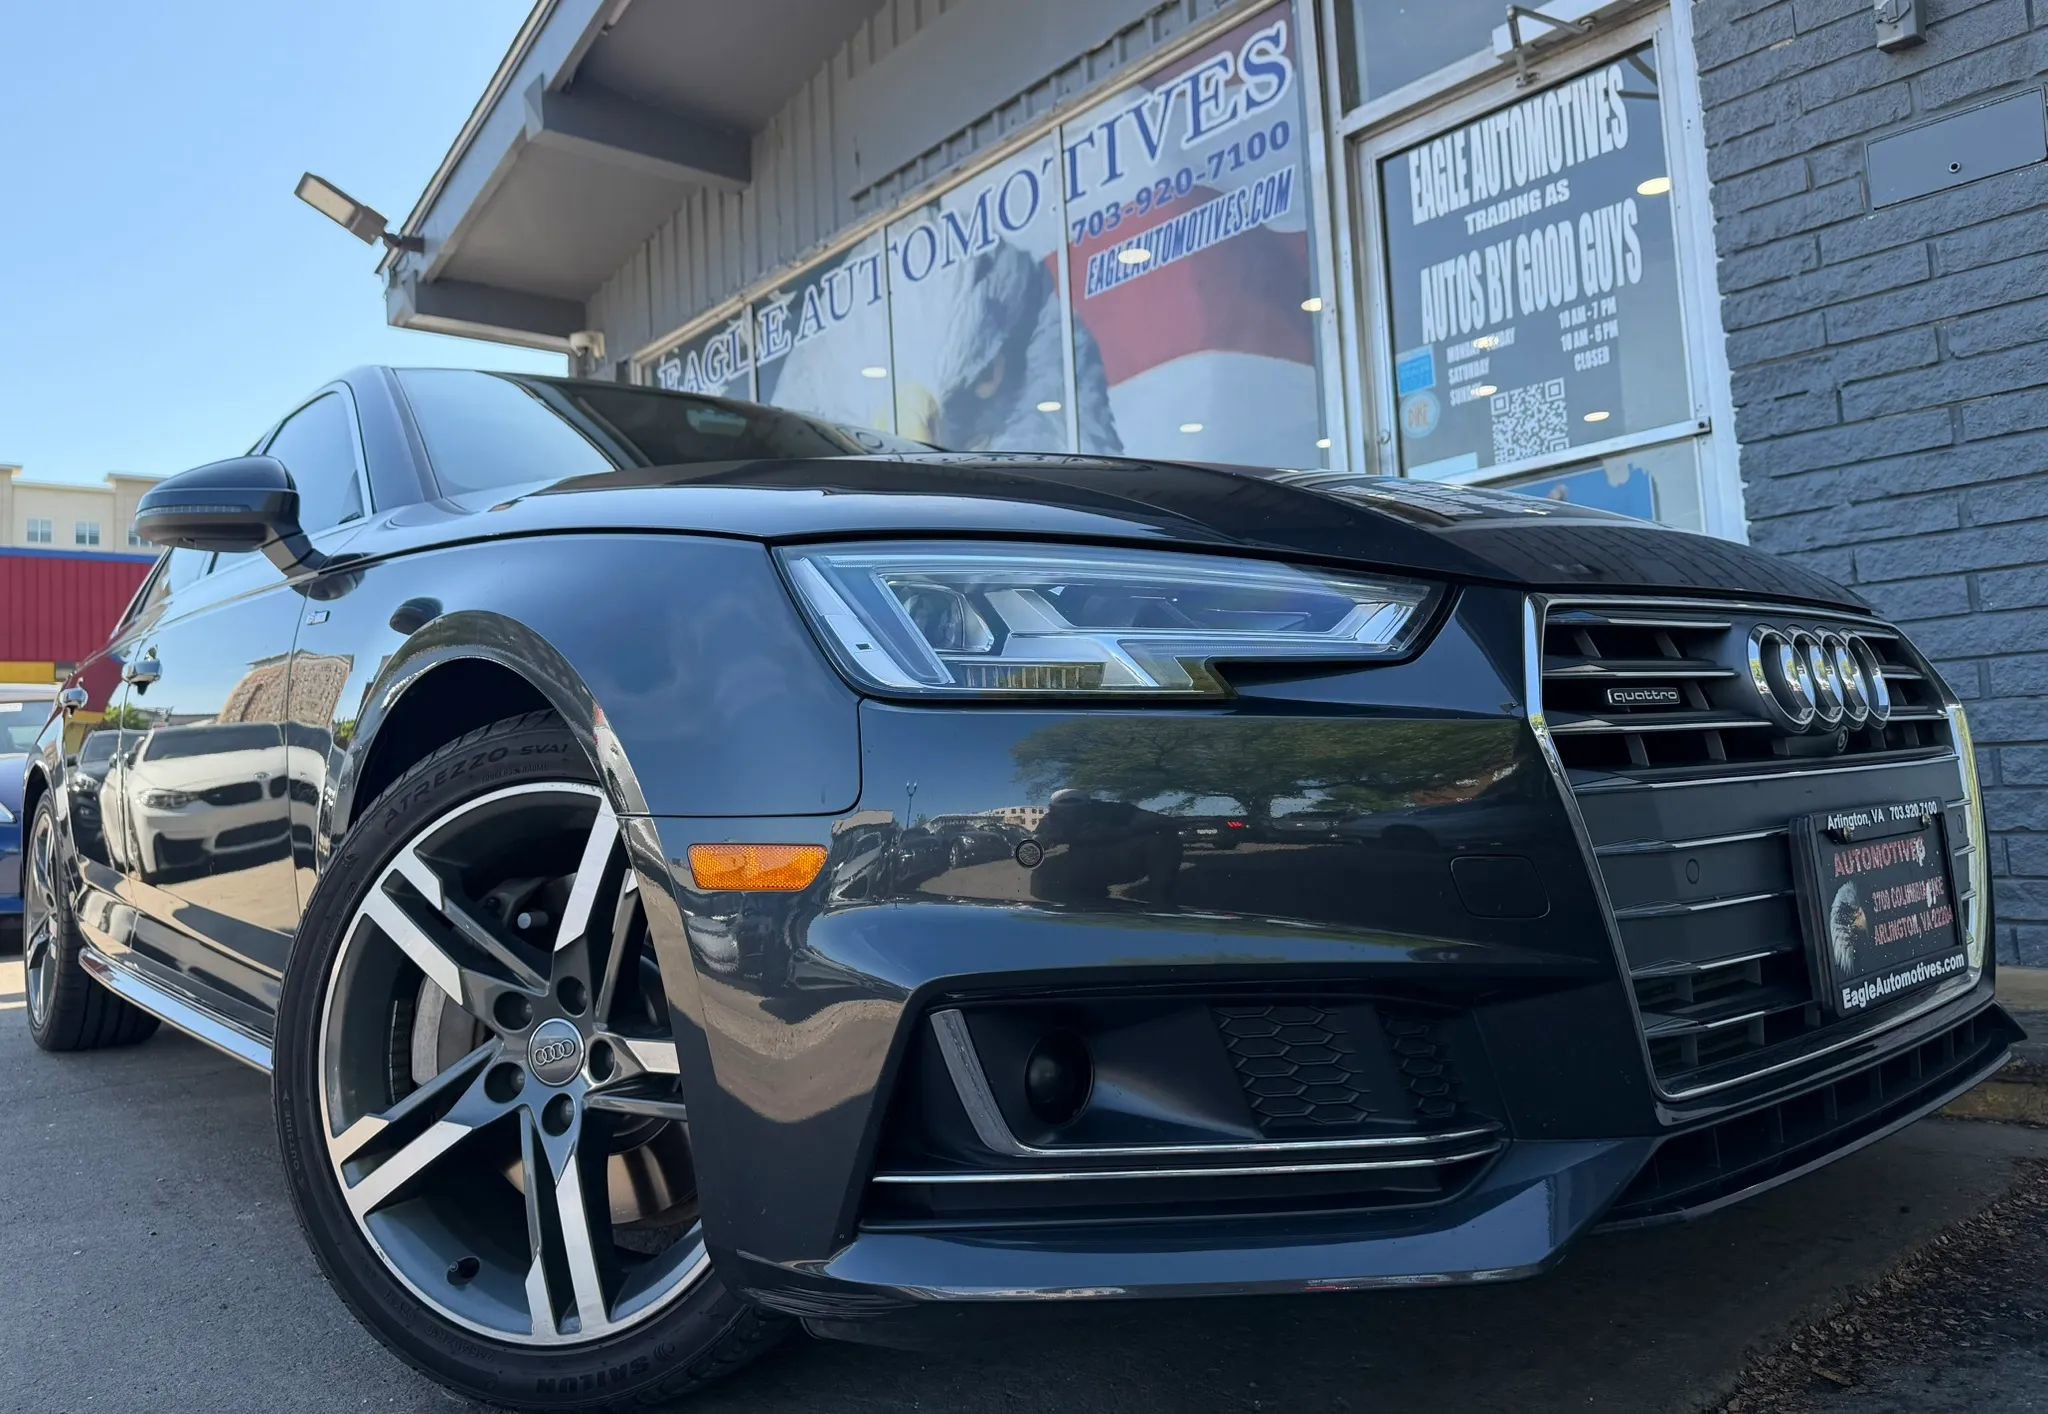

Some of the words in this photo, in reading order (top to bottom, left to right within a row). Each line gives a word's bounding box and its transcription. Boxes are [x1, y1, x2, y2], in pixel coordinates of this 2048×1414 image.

[1408, 130, 1470, 226] EAGLE
[1470, 63, 1629, 204] AUTOMOTIVES
[657, 302, 792, 392] EAGLE
[794, 19, 1297, 344] AUTOMOTIVES
[1071, 119, 1291, 246] 703-920-7100
[1464, 188, 1542, 235] TRADING
[1545, 178, 1570, 207] AS
[1084, 165, 1295, 299] EAGLEAUTOMOTIVES.COM
[1420, 249, 1486, 345] AUTOS
[1484, 239, 1514, 325] BY
[1515, 220, 1579, 316] GOOD
[1578, 197, 1643, 298] GUYS
[1600, 295, 1617, 317] PM
[1602, 319, 1619, 341] PM
[1574, 345, 1610, 372] CLOSED
[1613, 689, 1678, 704] quattro
[384, 746, 508, 828] ATREZZO
[1827, 812, 1872, 831] Arlington,
[1870, 808, 1885, 823] VA
[1889, 801, 1938, 820] 703.920.7100
[1919, 907, 1934, 932] VA
[1842, 953, 1966, 1009] EagleAutomotives.com
